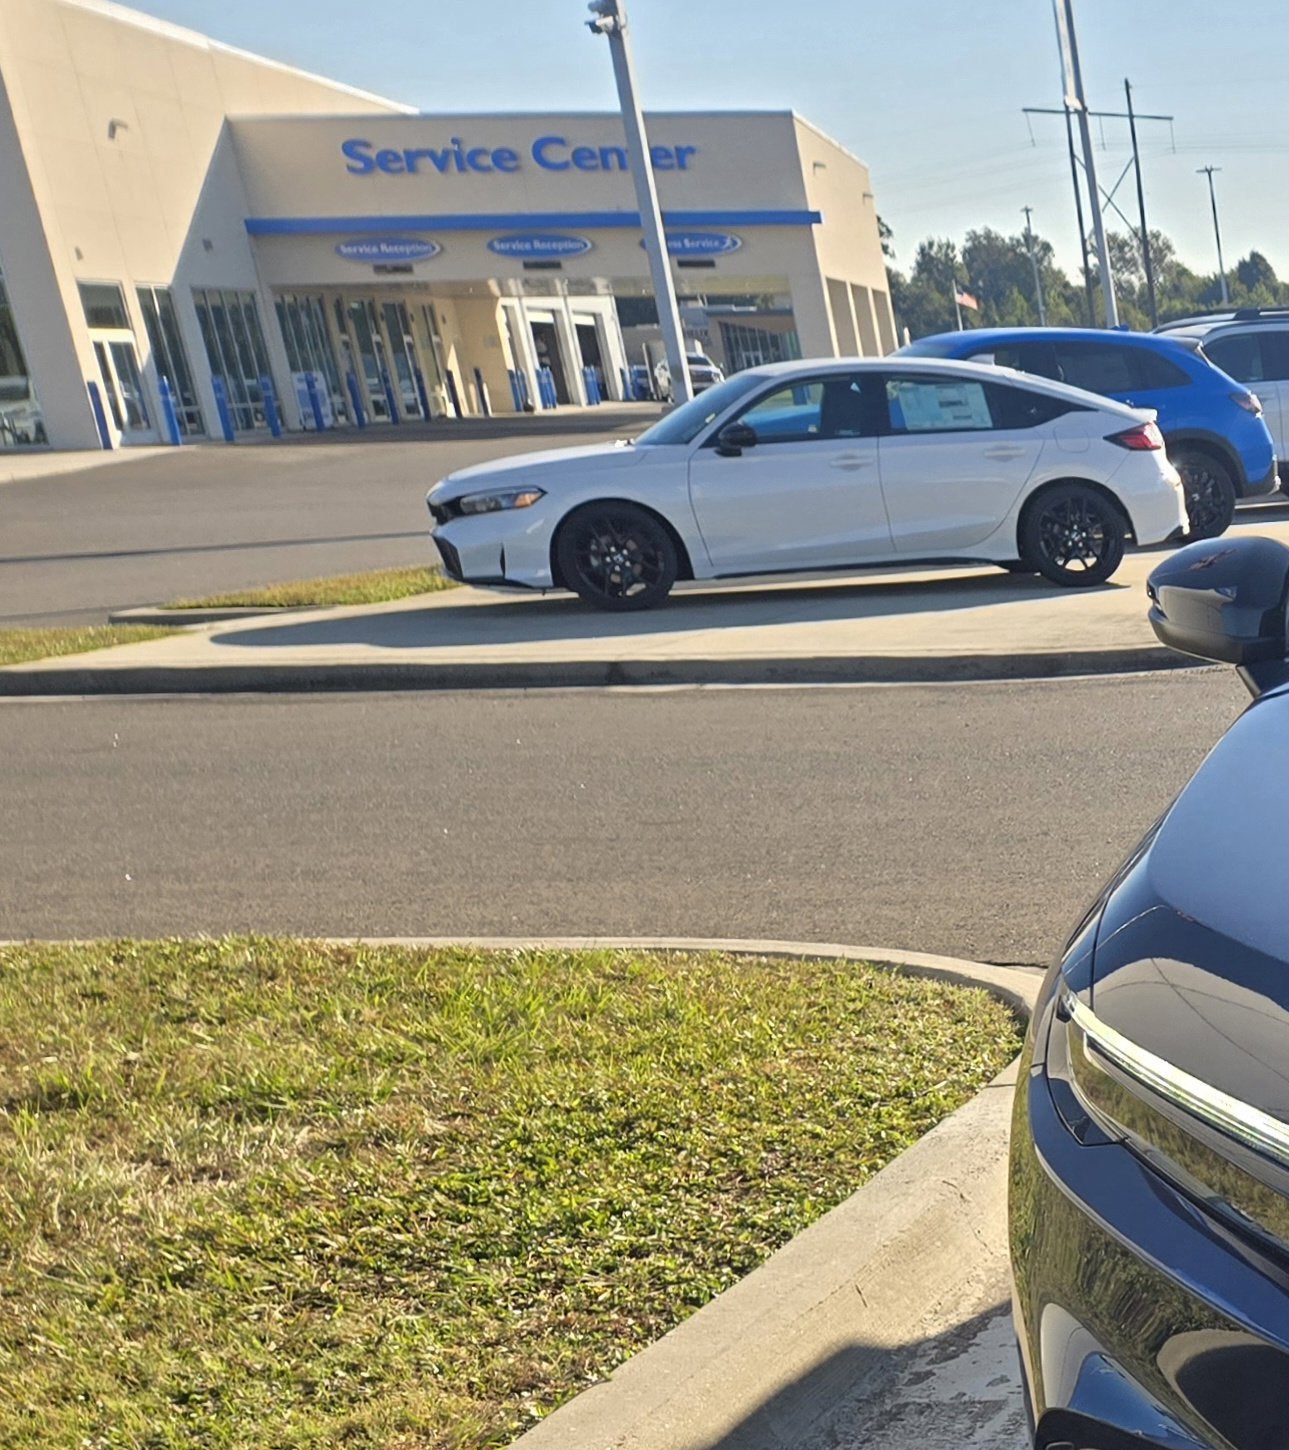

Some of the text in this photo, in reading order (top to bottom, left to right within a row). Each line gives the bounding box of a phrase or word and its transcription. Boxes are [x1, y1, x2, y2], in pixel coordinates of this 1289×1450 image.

[341, 136, 697, 174] Service Cener
[340, 242, 433, 255] Service Reception
[493, 239, 585, 251] Service Reception
[684, 238, 719, 248] Service
